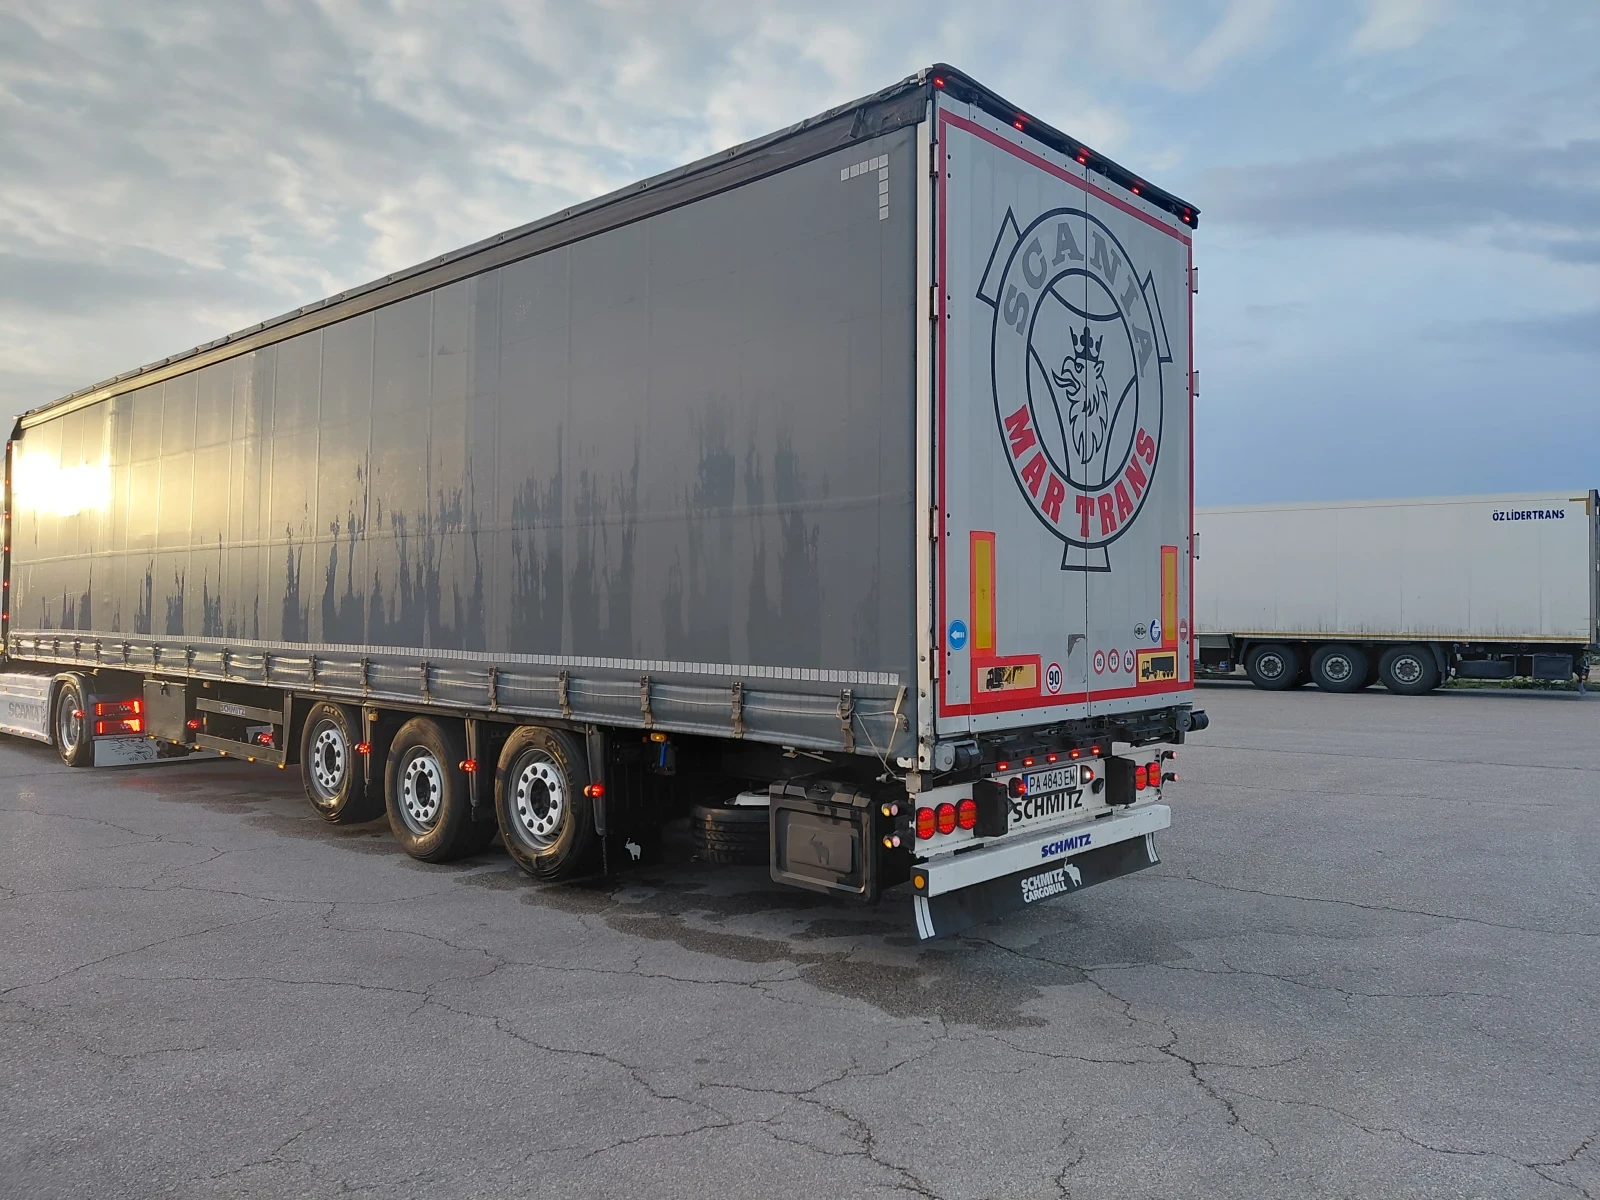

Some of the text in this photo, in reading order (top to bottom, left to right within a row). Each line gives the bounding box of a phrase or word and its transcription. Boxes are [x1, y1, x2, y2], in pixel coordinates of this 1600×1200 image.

[1003, 222, 1154, 378] SCANIA
[1004, 403, 1156, 538] MAR TRANS
[1492, 508, 1565, 521] ÖZ LİDERTRANS
[1048, 670, 1060, 686] 90
[8, 702, 40, 722] SCANIA
[1029, 776, 1041, 793] PA
[1042, 770, 1063, 790] 4843
[1012, 789, 1083, 823] SCHMITZ
[1041, 833, 1092, 859] SCHMITZ
[1020, 867, 1065, 894] SCHMITZ
[1023, 881, 1068, 904] CARGOBULL
